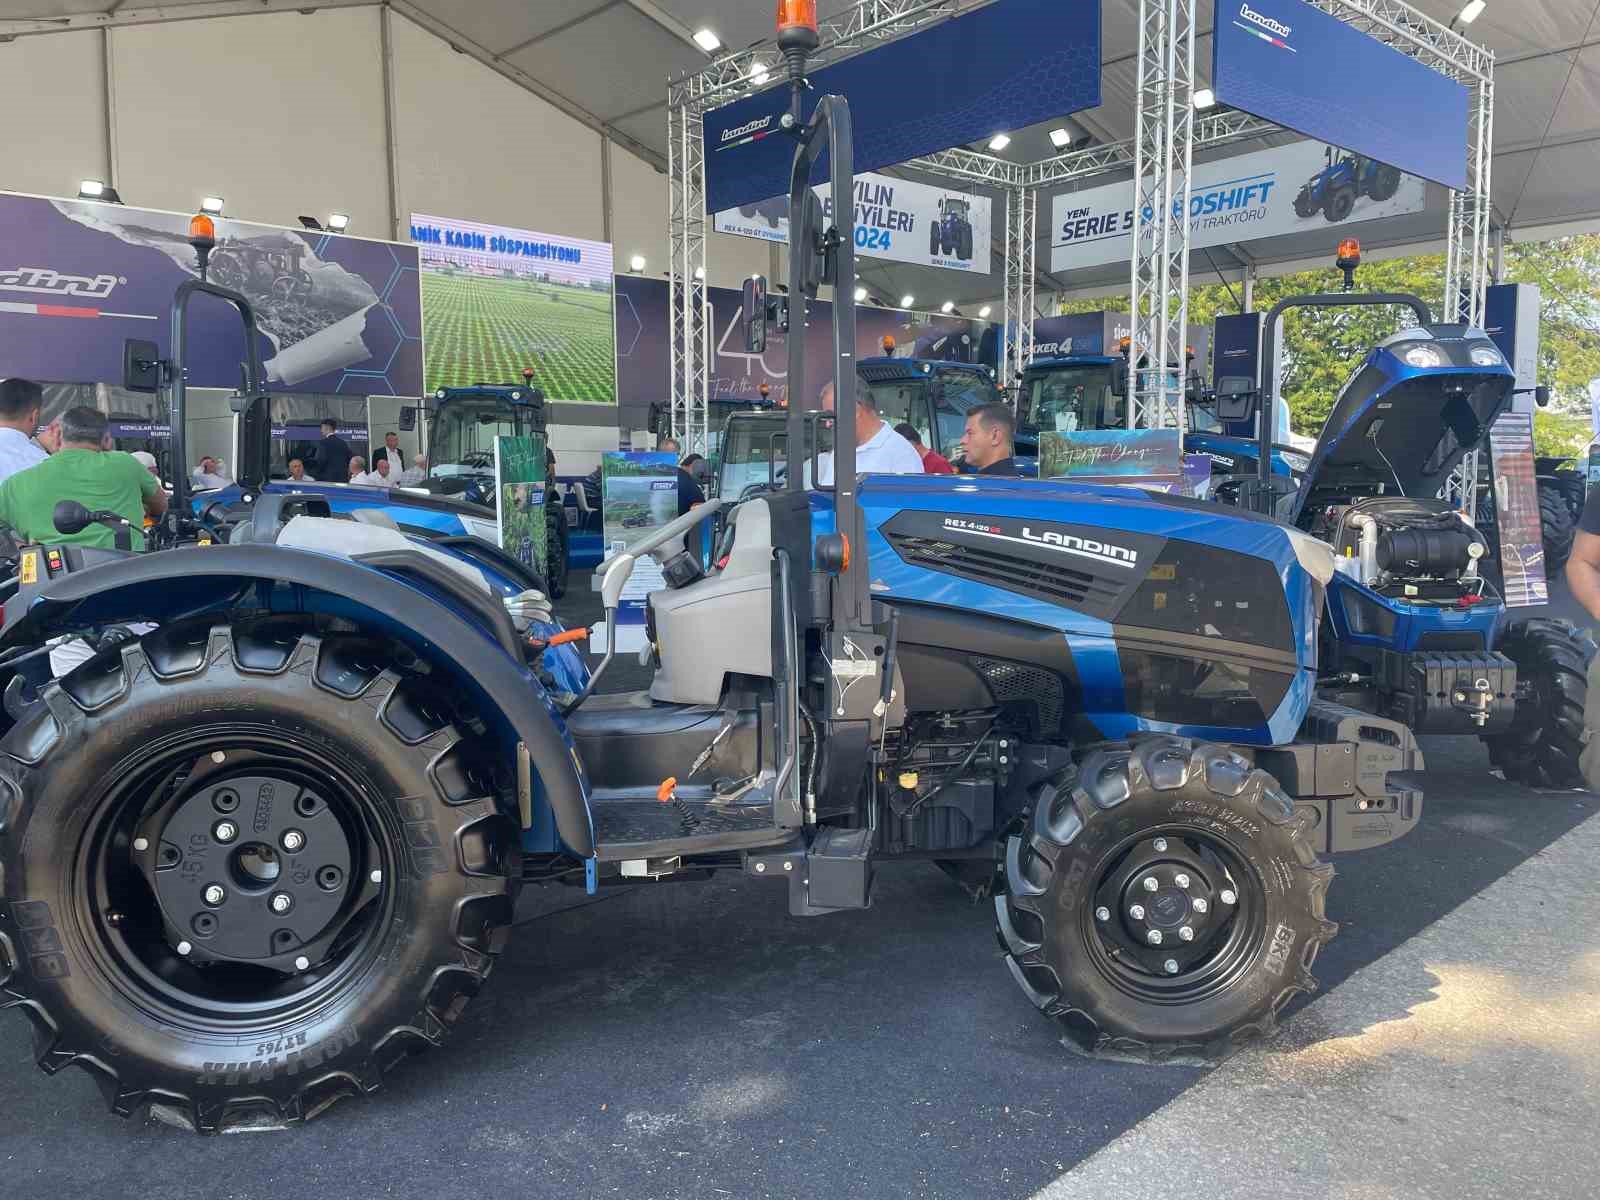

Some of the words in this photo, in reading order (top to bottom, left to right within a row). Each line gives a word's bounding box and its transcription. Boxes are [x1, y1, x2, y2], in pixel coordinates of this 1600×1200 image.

[1240, 3, 1290, 37] Landini
[1061, 212, 1118, 241] SERIE
[945, 518, 967, 528] REX
[1022, 527, 1137, 562] LANDINI
